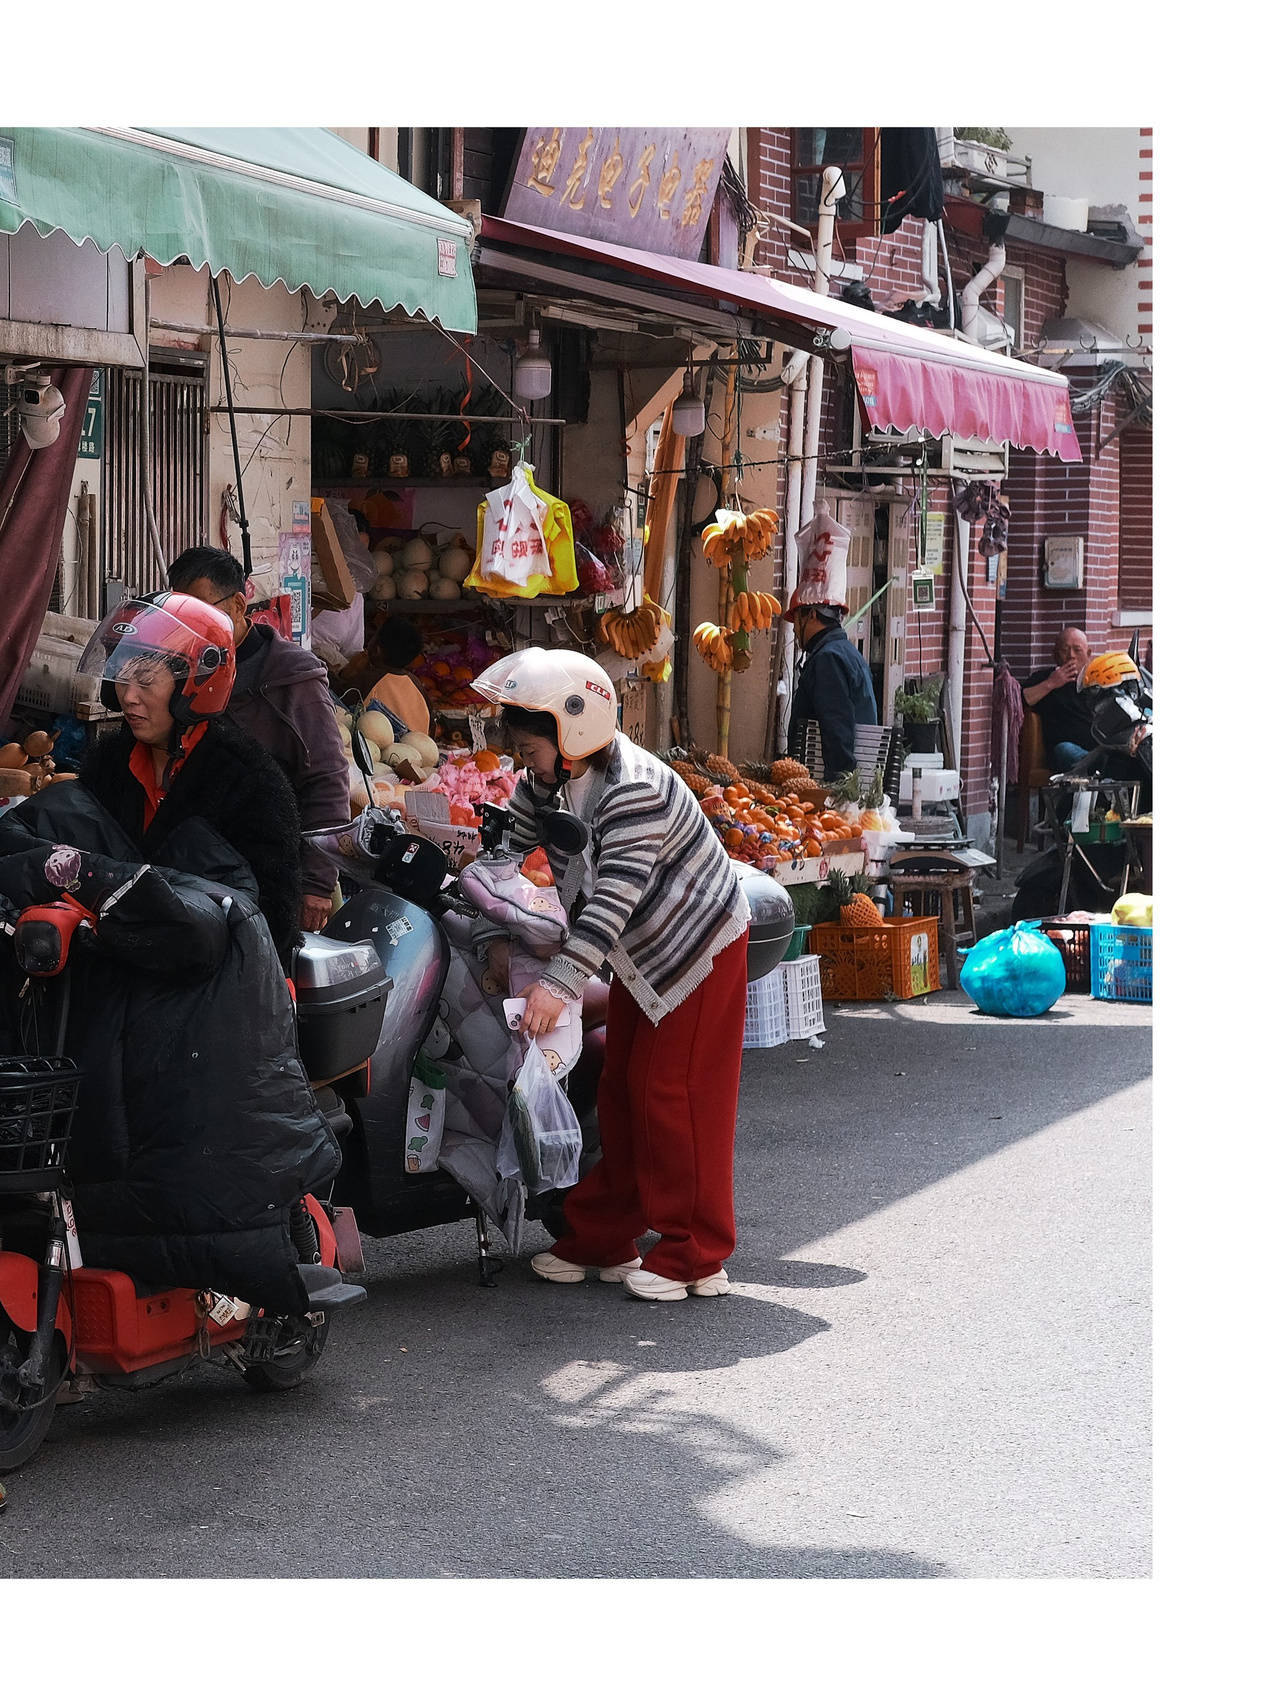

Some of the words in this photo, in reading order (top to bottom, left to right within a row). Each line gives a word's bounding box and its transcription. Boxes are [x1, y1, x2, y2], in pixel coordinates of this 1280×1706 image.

[81, 407, 96, 437] 7
[590, 684, 608, 698] CLF
[64, 1199, 77, 1238] aige
